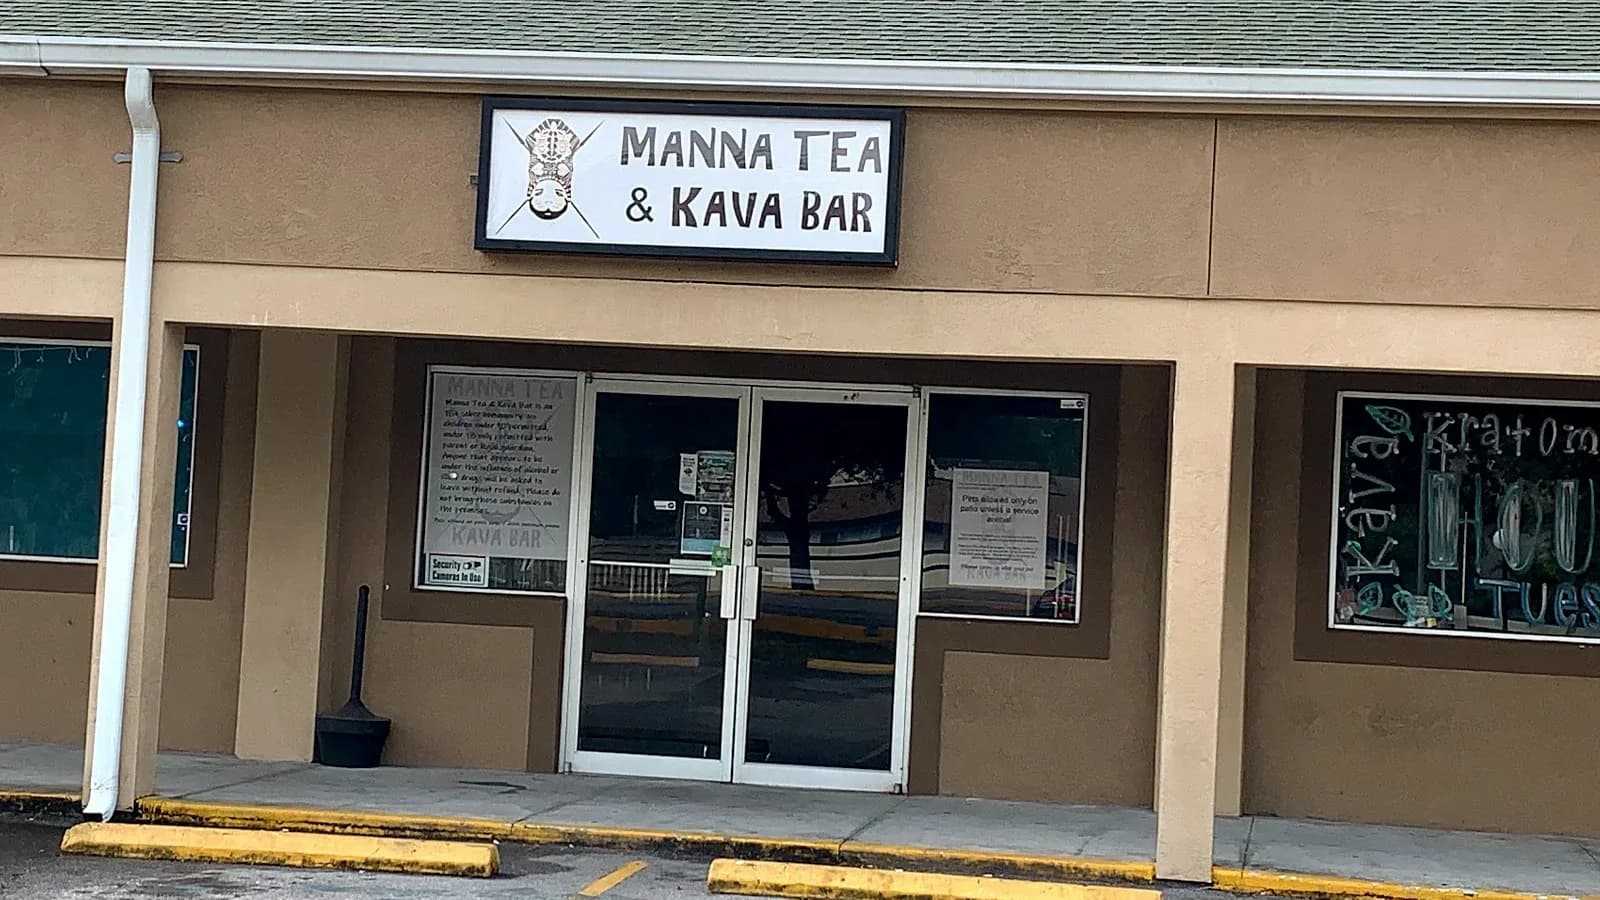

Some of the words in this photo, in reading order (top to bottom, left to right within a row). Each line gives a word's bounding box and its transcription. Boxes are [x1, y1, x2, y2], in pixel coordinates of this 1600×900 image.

[620, 125, 773, 171] MANNA
[794, 130, 882, 174] TEA
[625, 186, 654, 224] &
[671, 186, 783, 229] KAVA
[800, 190, 873, 233] BAR
[448, 376, 515, 398] MANNA
[524, 379, 563, 400] TEA
[1423, 412, 1599, 457] Kratom
[962, 494, 979, 503] Pets
[981, 495, 1009, 504] allowed
[1011, 496, 1027, 506] only
[1028, 497, 1038, 505] on
[980, 506, 1004, 514] unless
[1013, 507, 1040, 515] service
[1345, 434, 1400, 577] Kava
[452, 527, 502, 545] KAVA
[509, 529, 541, 548] BAR
[432, 558, 461, 571] Security
[432, 571, 460, 582] Cameras
[470, 573, 481, 583] Use
